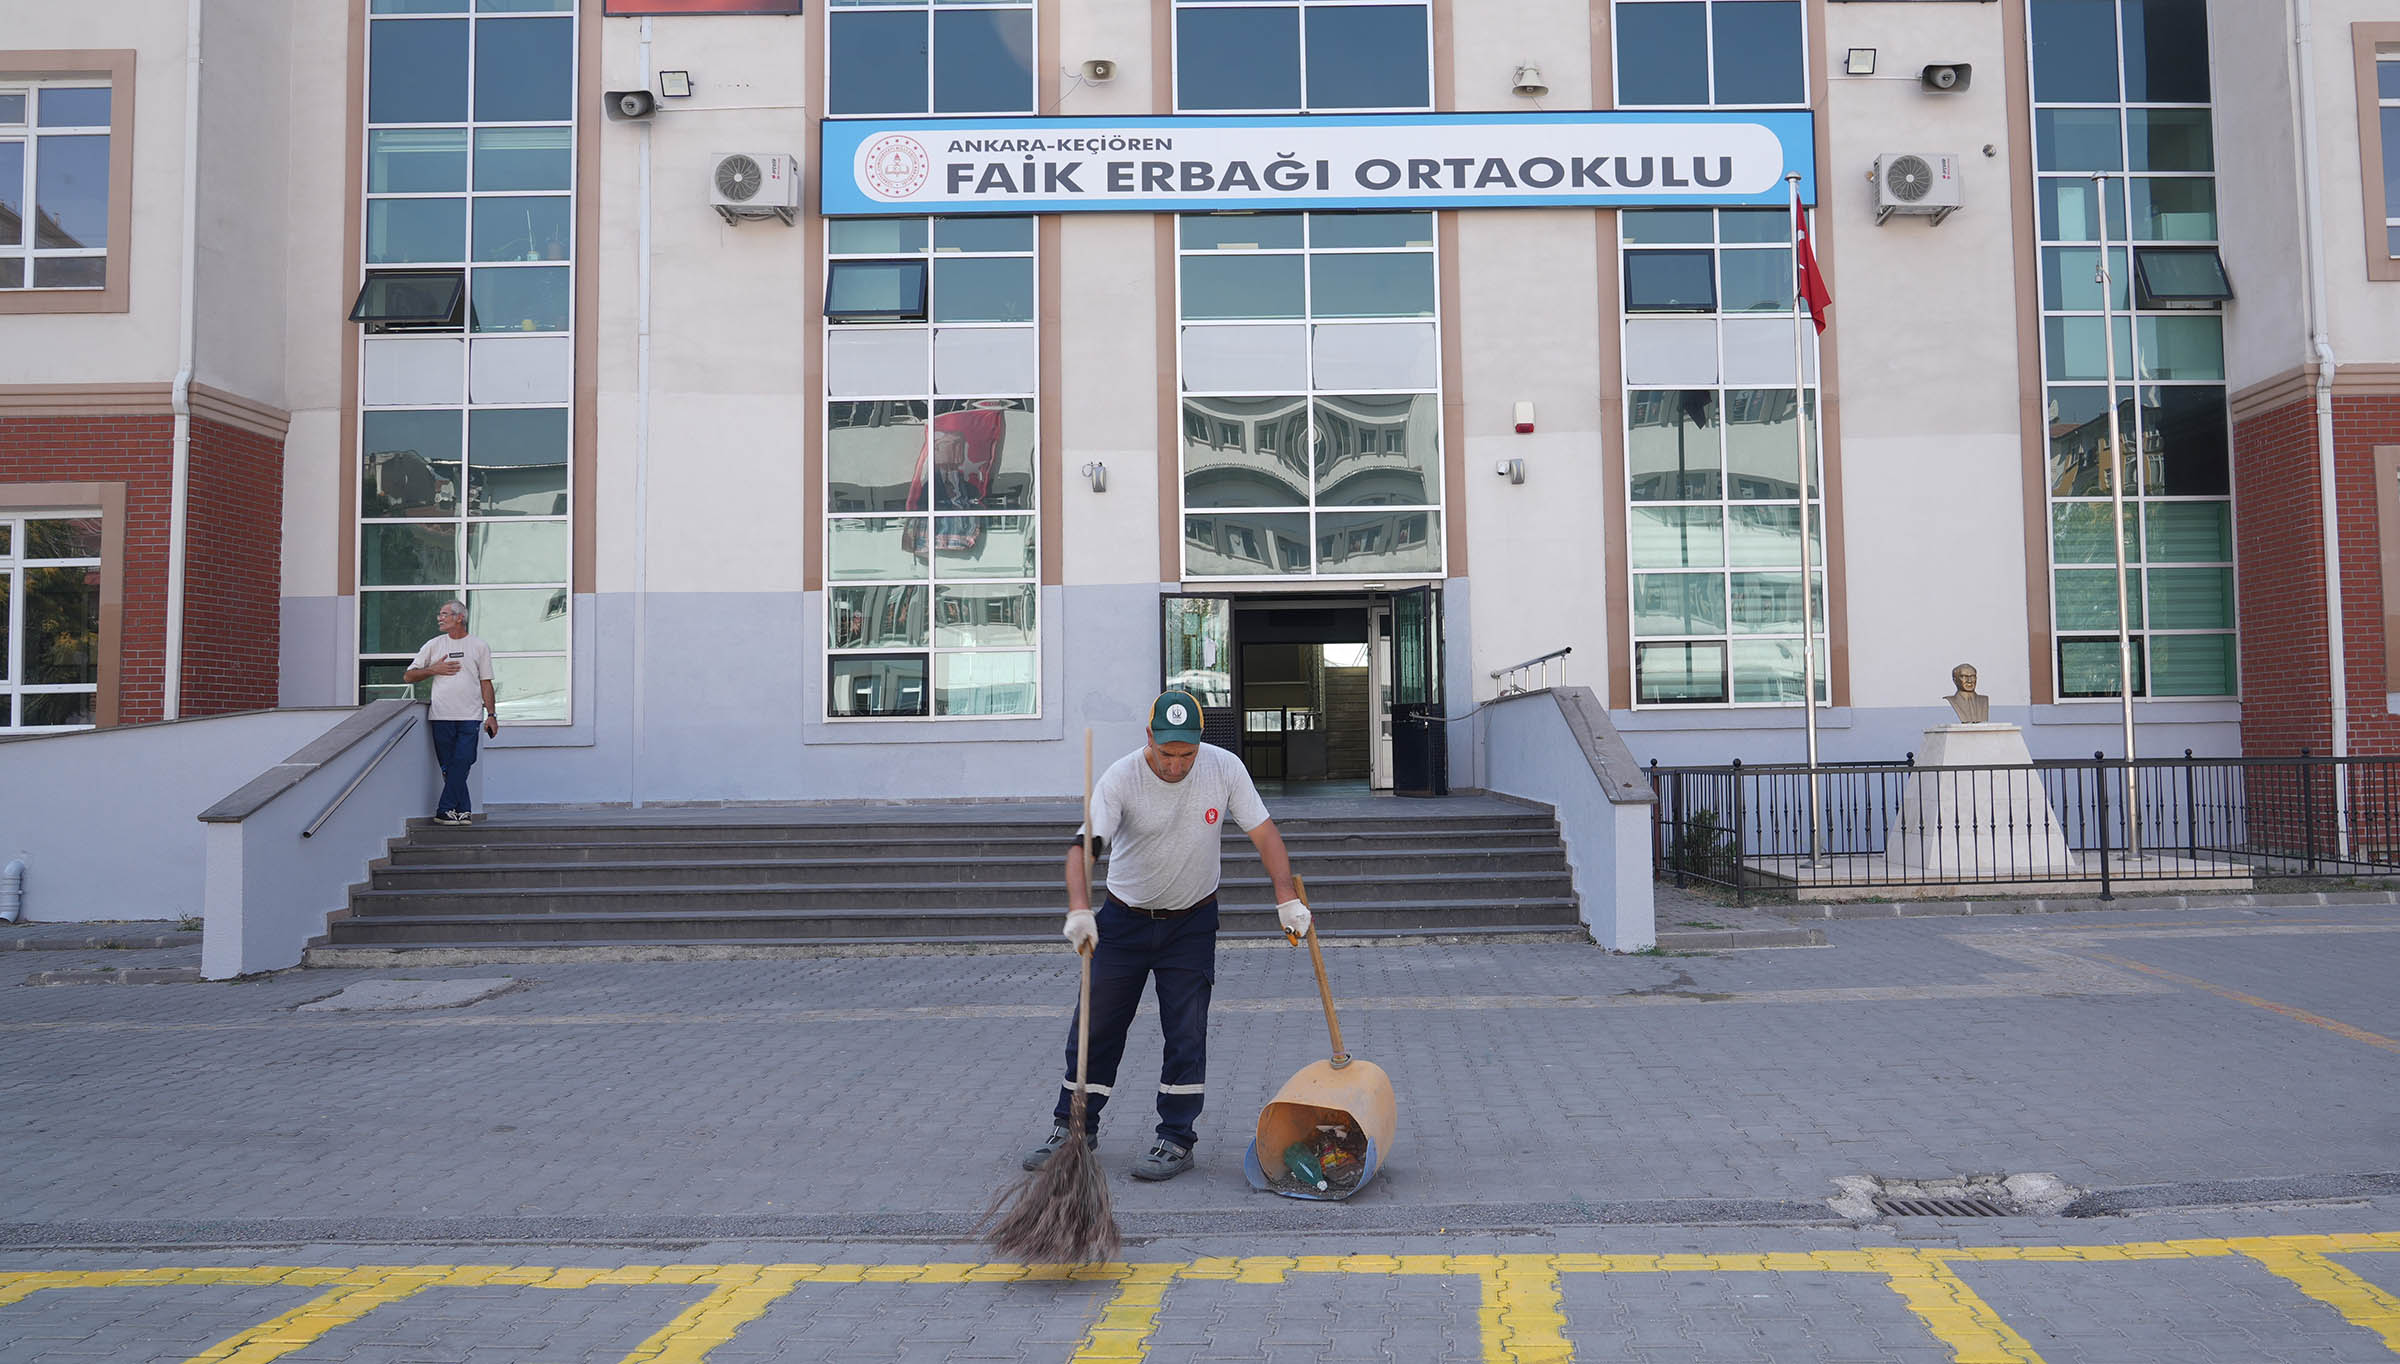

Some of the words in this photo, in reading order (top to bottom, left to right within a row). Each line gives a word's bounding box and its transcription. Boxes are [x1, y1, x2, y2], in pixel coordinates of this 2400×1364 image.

[947, 135, 1173, 155] ANKARA-KEÇİÖREN
[946, 154, 1085, 194] FAİK
[1107, 151, 1330, 192] ERBAĞI
[1354, 156, 1733, 190] ORTAOKULU
